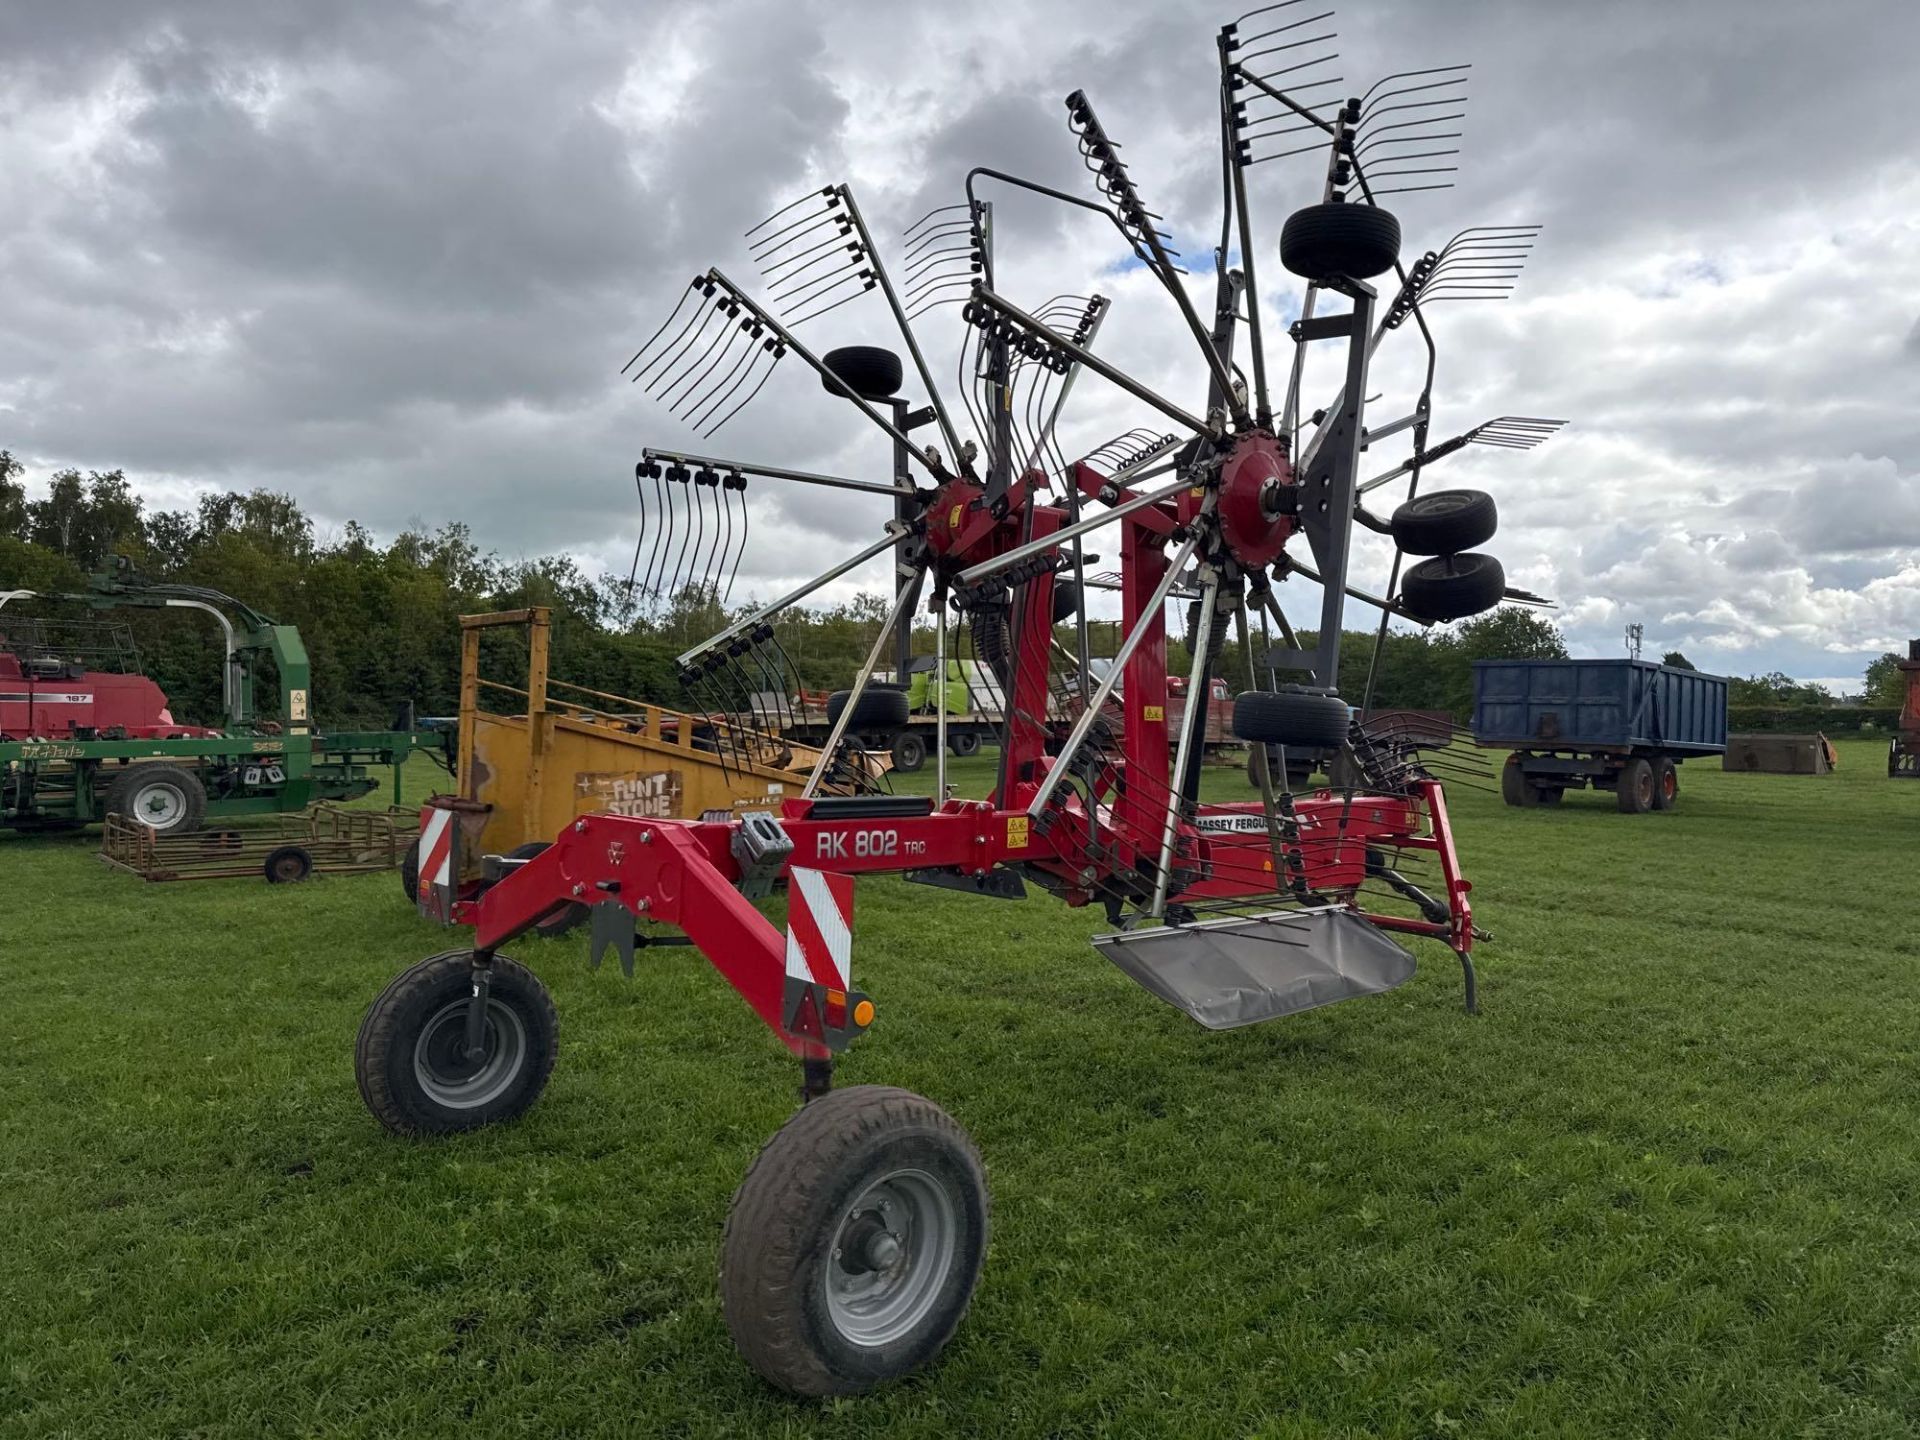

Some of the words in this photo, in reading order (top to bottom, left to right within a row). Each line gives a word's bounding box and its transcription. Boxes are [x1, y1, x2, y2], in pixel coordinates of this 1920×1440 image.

[612, 774, 667, 801] FLINT
[608, 795, 671, 816] STONE
[817, 832, 848, 859] RK
[855, 829, 897, 857] 802
[904, 841, 926, 855] TRC
